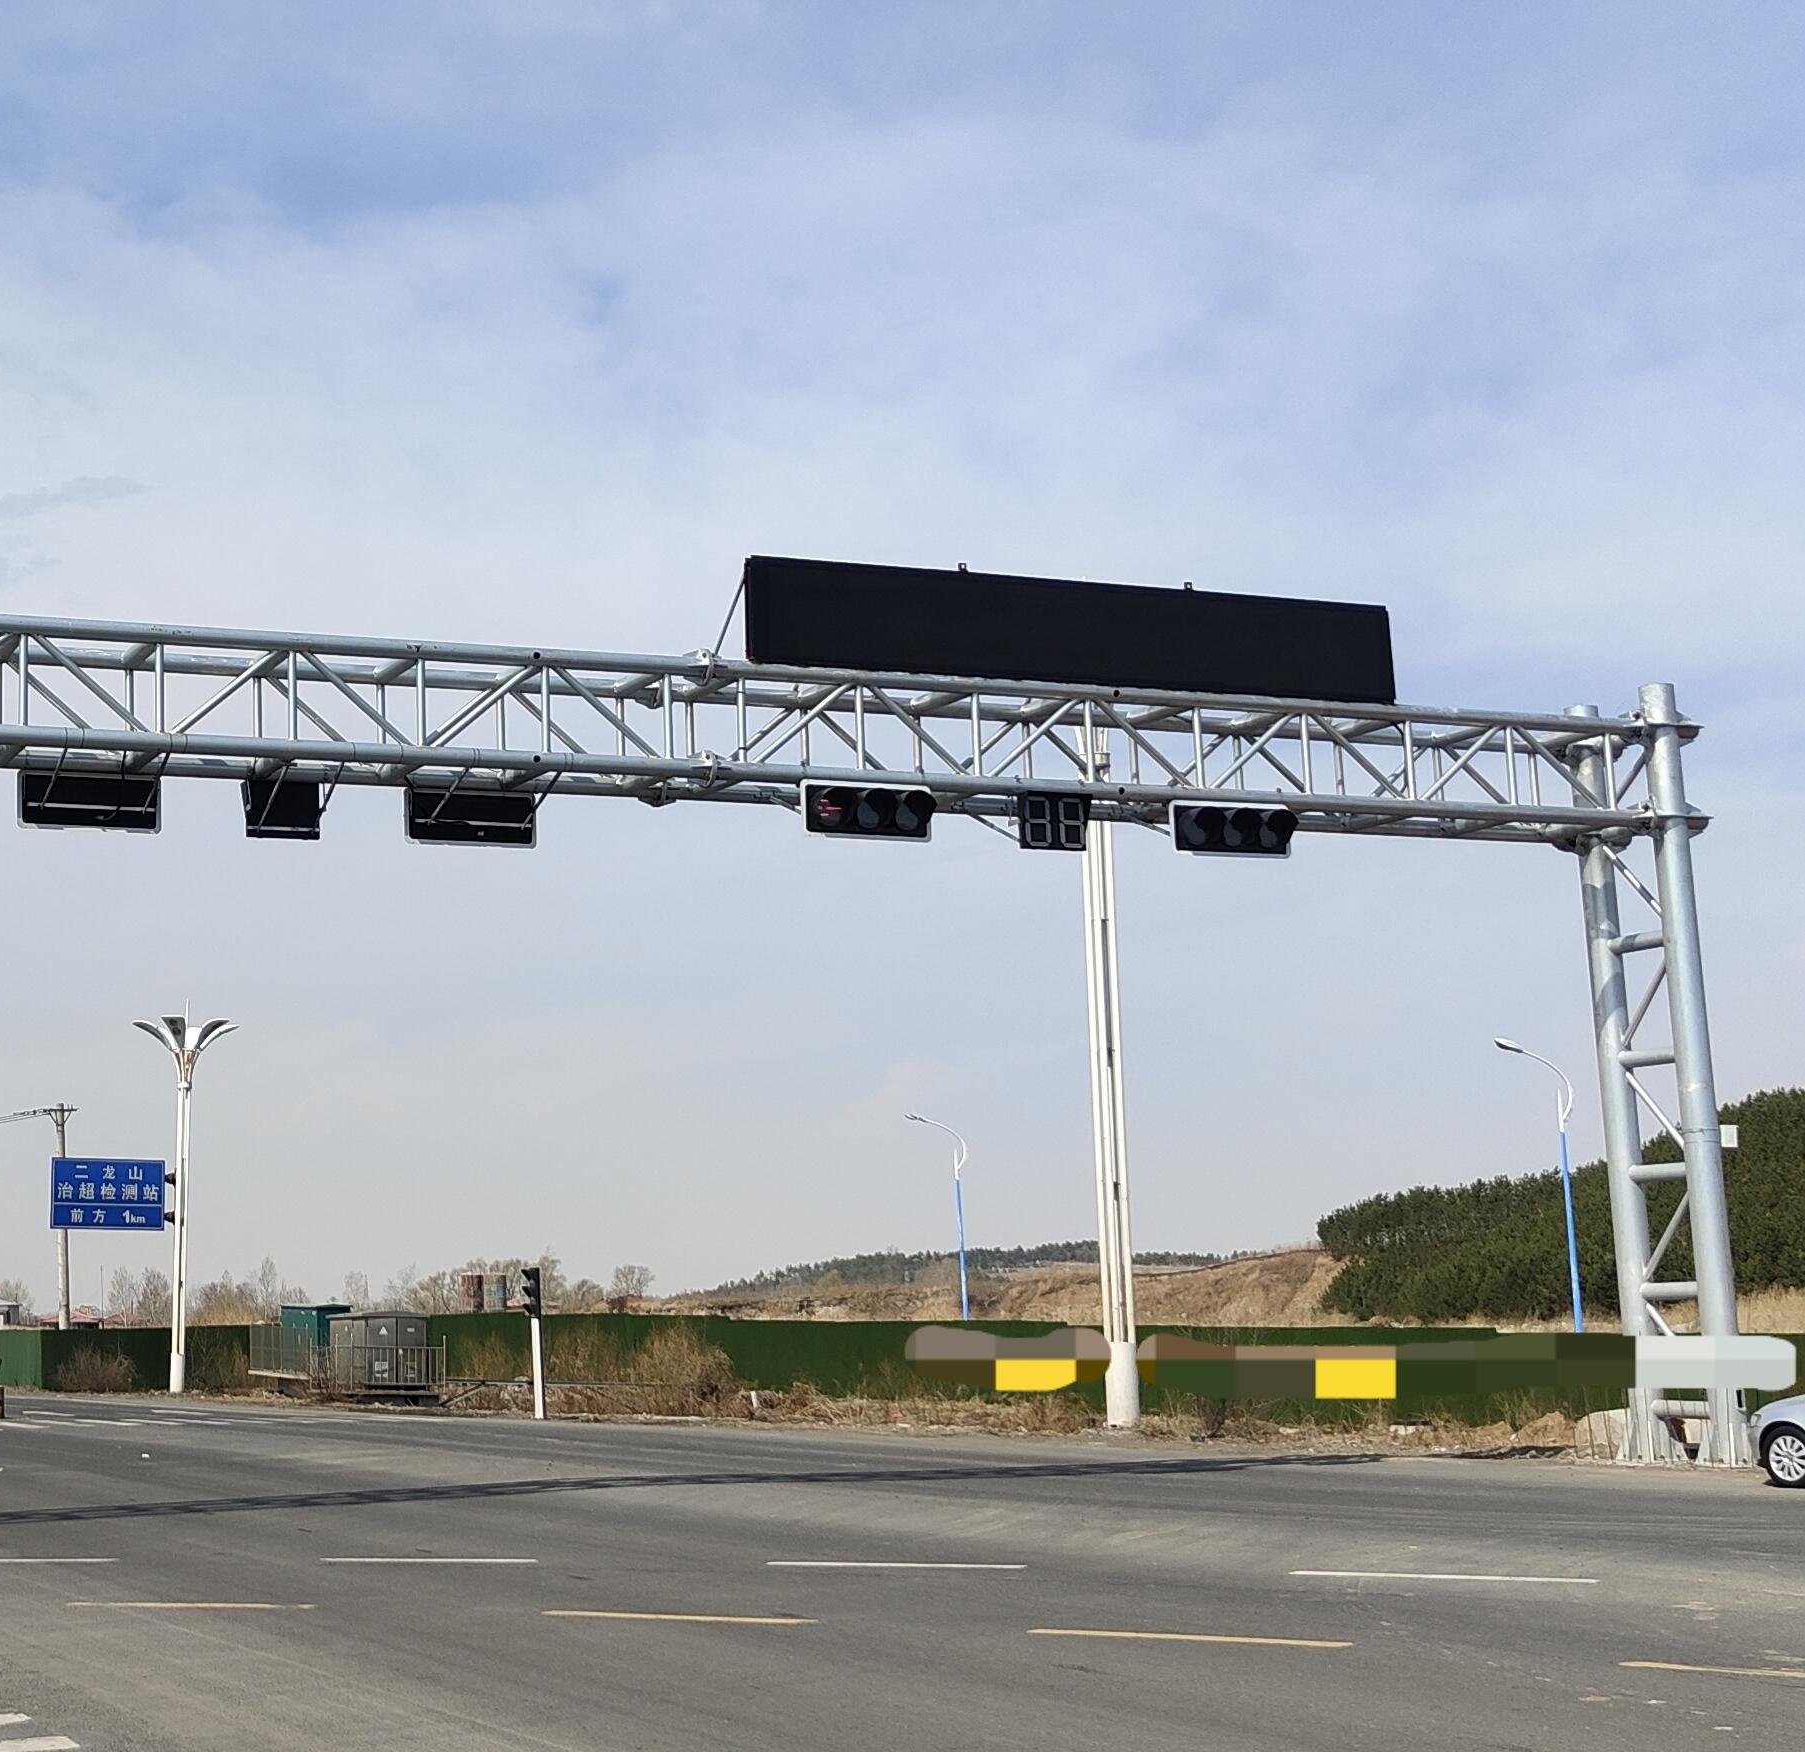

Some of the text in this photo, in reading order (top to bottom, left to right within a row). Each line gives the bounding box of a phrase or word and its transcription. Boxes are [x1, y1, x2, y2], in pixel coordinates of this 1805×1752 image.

[74, 1164, 143, 1181] 二龙山
[57, 1181, 159, 1201] 治超检测站
[70, 1207, 146, 1224] 前方 1km
